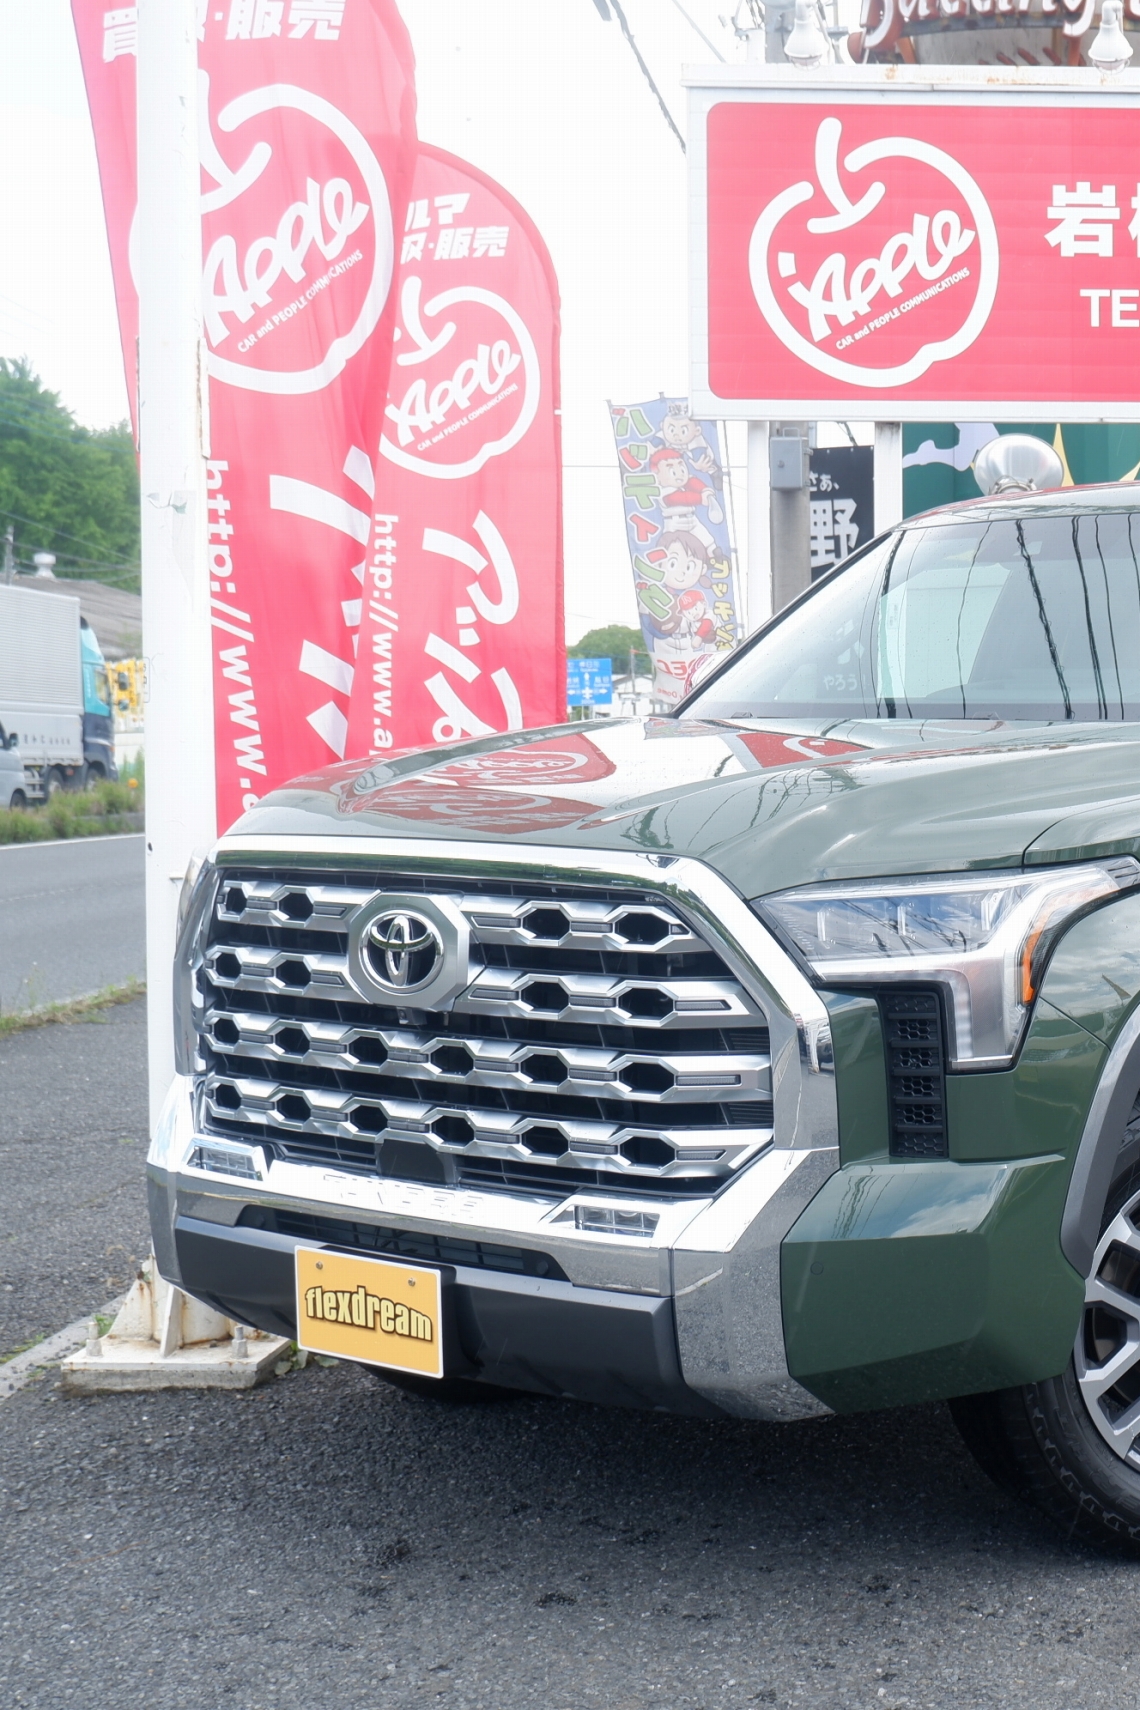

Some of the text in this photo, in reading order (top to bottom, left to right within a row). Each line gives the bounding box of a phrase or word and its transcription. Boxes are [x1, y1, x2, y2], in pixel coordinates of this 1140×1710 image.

[201, 176, 370, 348] Apple
[787, 209, 976, 343] Apple
[835, 267, 970, 350] CAR and PEOPLE COMMUNICATIONS
[237, 333, 258, 353] CAR
[256, 319, 274, 338] and
[272, 295, 308, 326] PEOPLE
[384, 340, 522, 447] Apple
[417, 383, 518, 451] CAR and PEOPLE COMMUNICATIONS
[370, 514, 399, 755] http://www.a
[304, 1285, 434, 1343] flexdream
